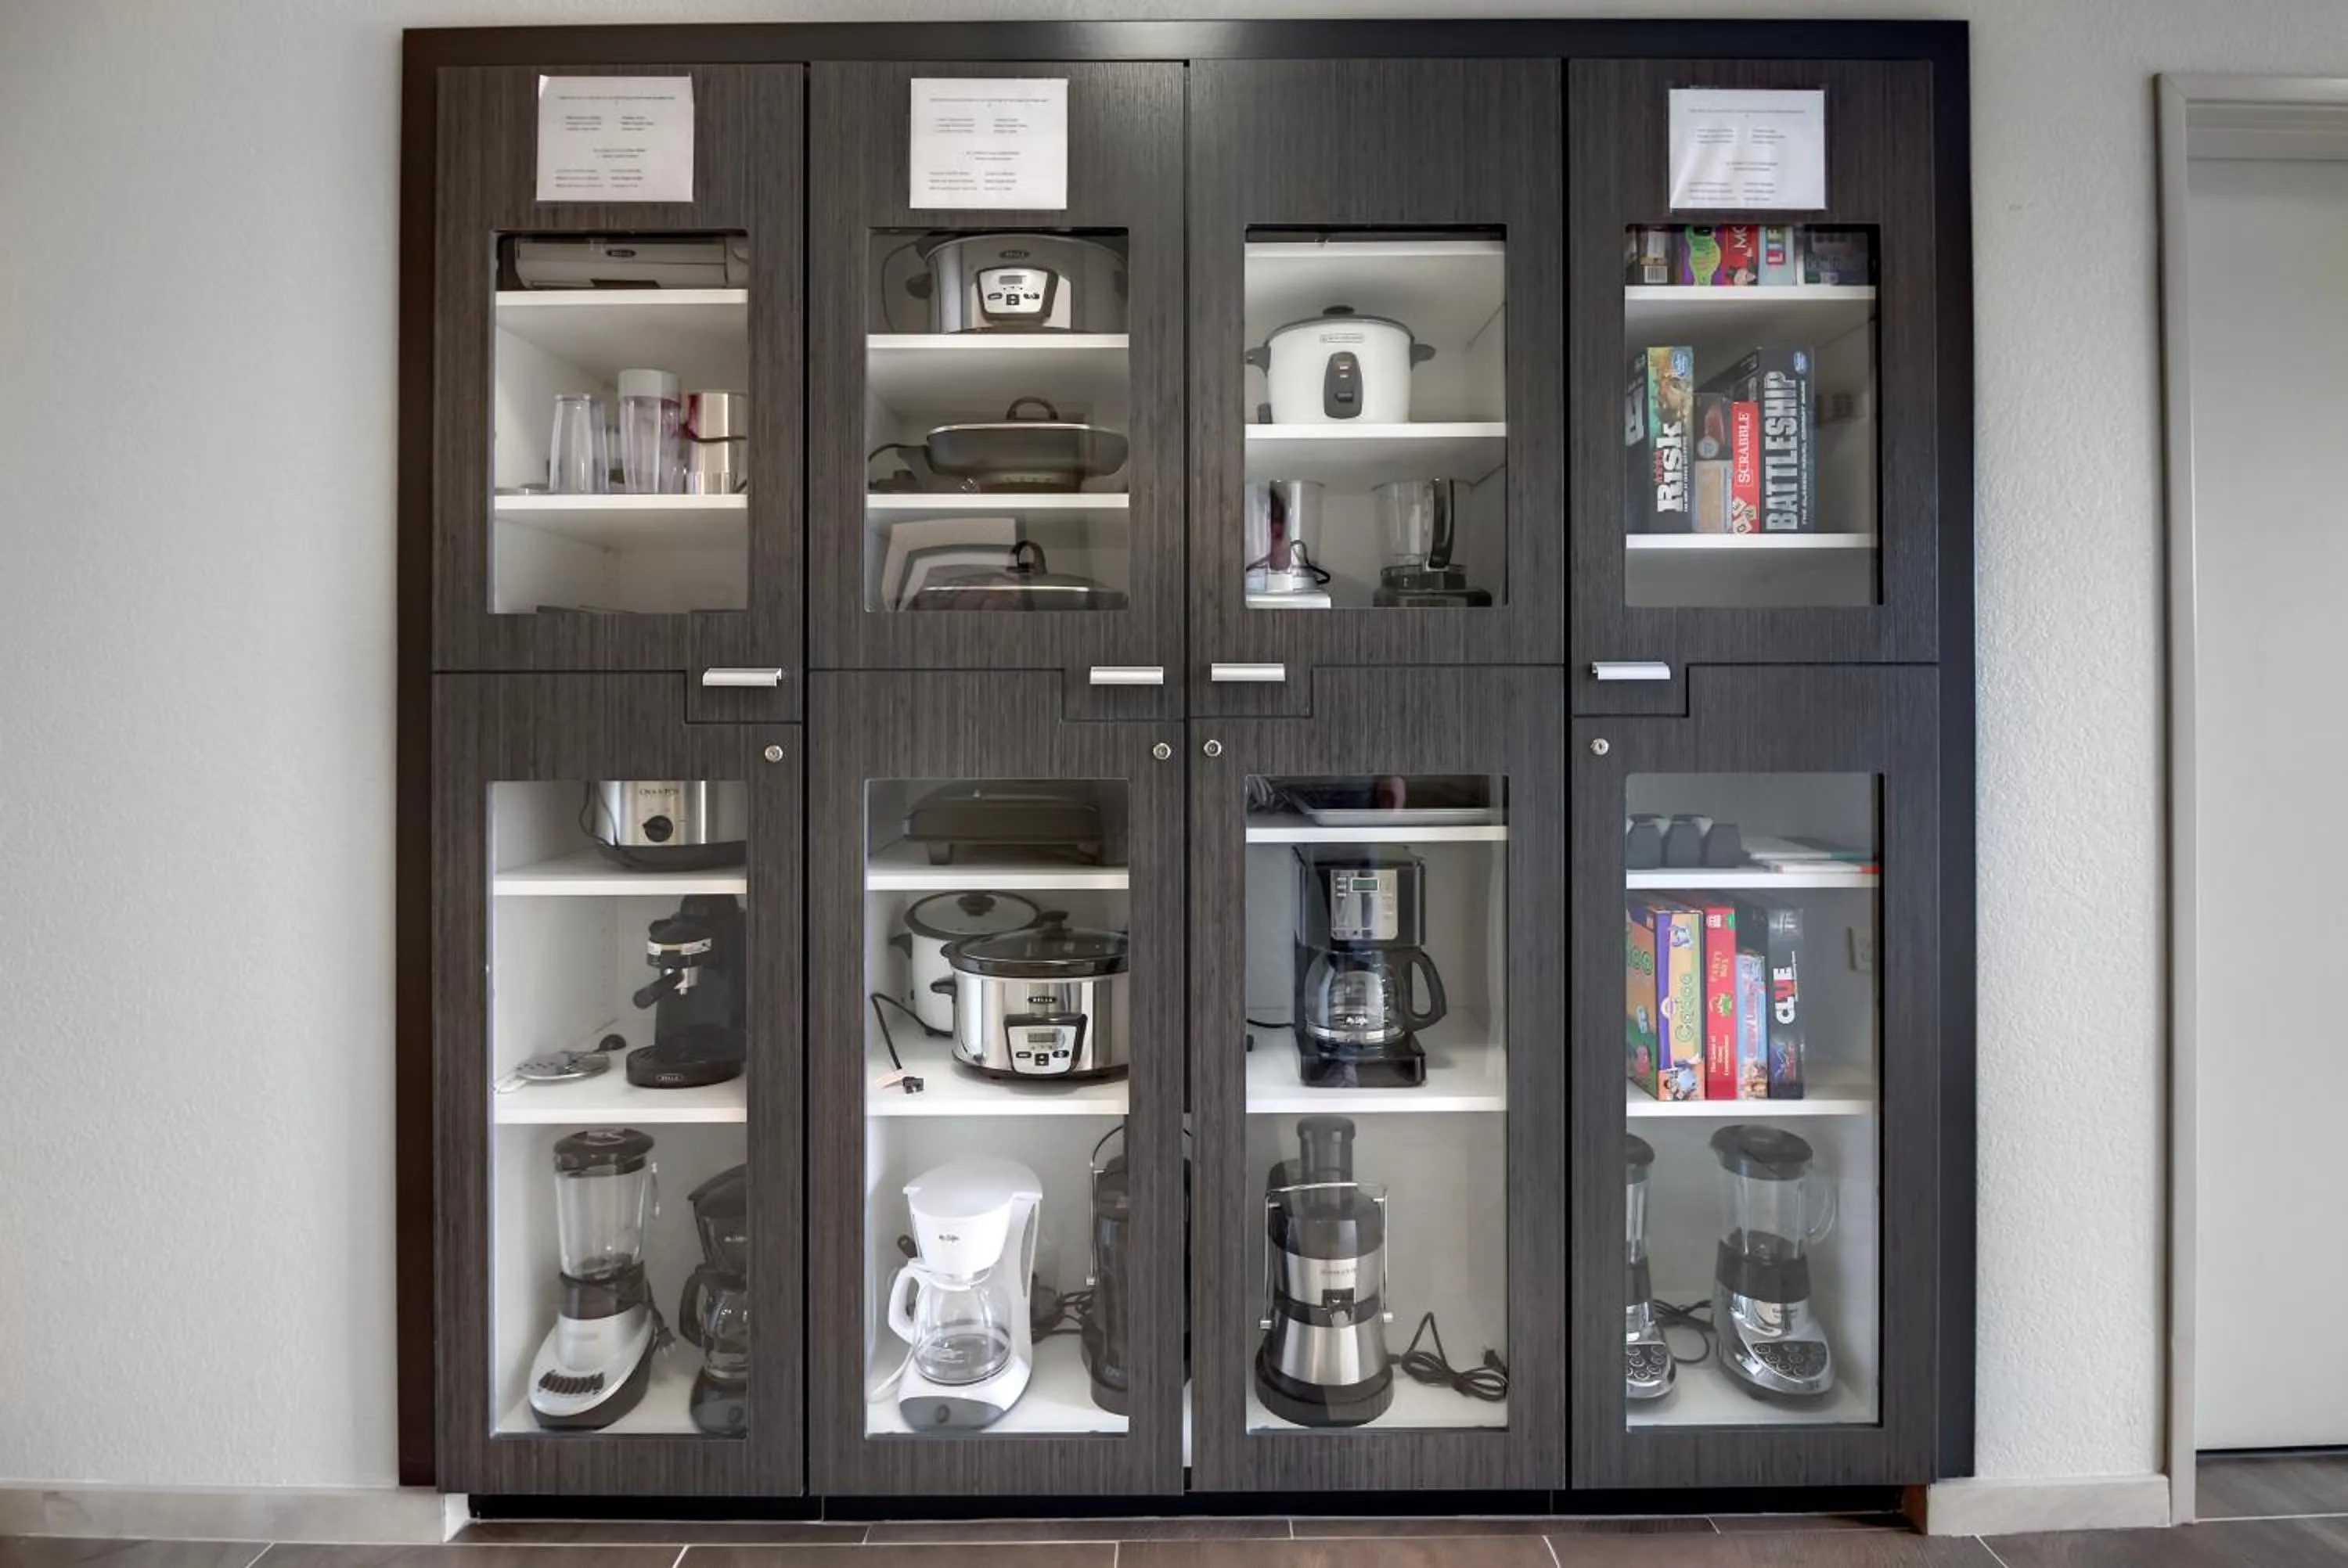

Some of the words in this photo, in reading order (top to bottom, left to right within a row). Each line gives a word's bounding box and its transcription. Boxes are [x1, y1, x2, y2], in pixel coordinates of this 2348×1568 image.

[1738, 412, 1751, 483] SCRABBLE
[1764, 370, 1799, 530] BATTLESHIP
[1773, 967, 1795, 1024] CLUE
